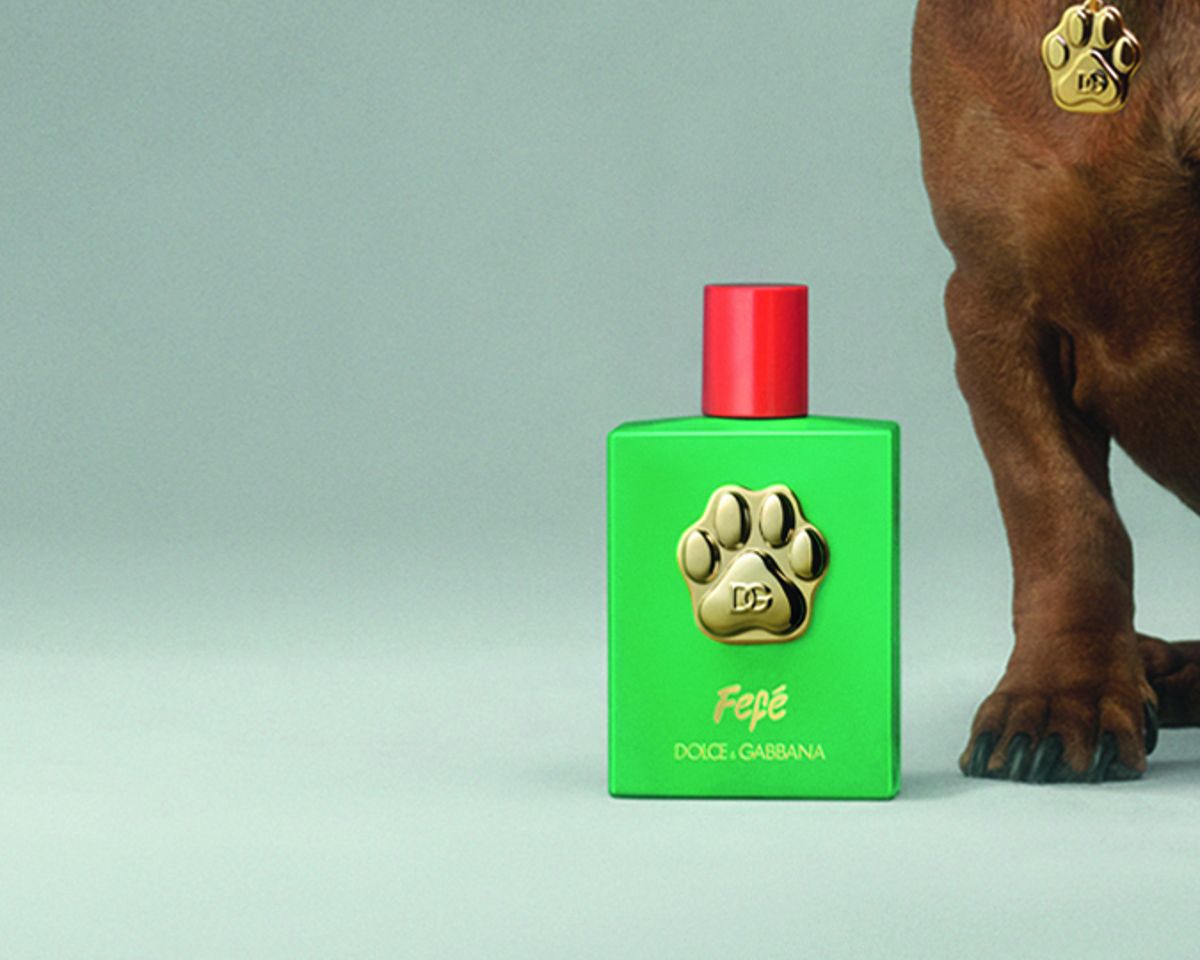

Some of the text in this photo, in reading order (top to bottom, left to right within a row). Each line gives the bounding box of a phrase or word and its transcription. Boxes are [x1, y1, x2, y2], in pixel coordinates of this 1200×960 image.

[731, 583, 773, 613] DG
[713, 684, 788, 732] Fefé
[673, 743, 727, 761] DOLCE
[738, 743, 826, 761] GABBANA
